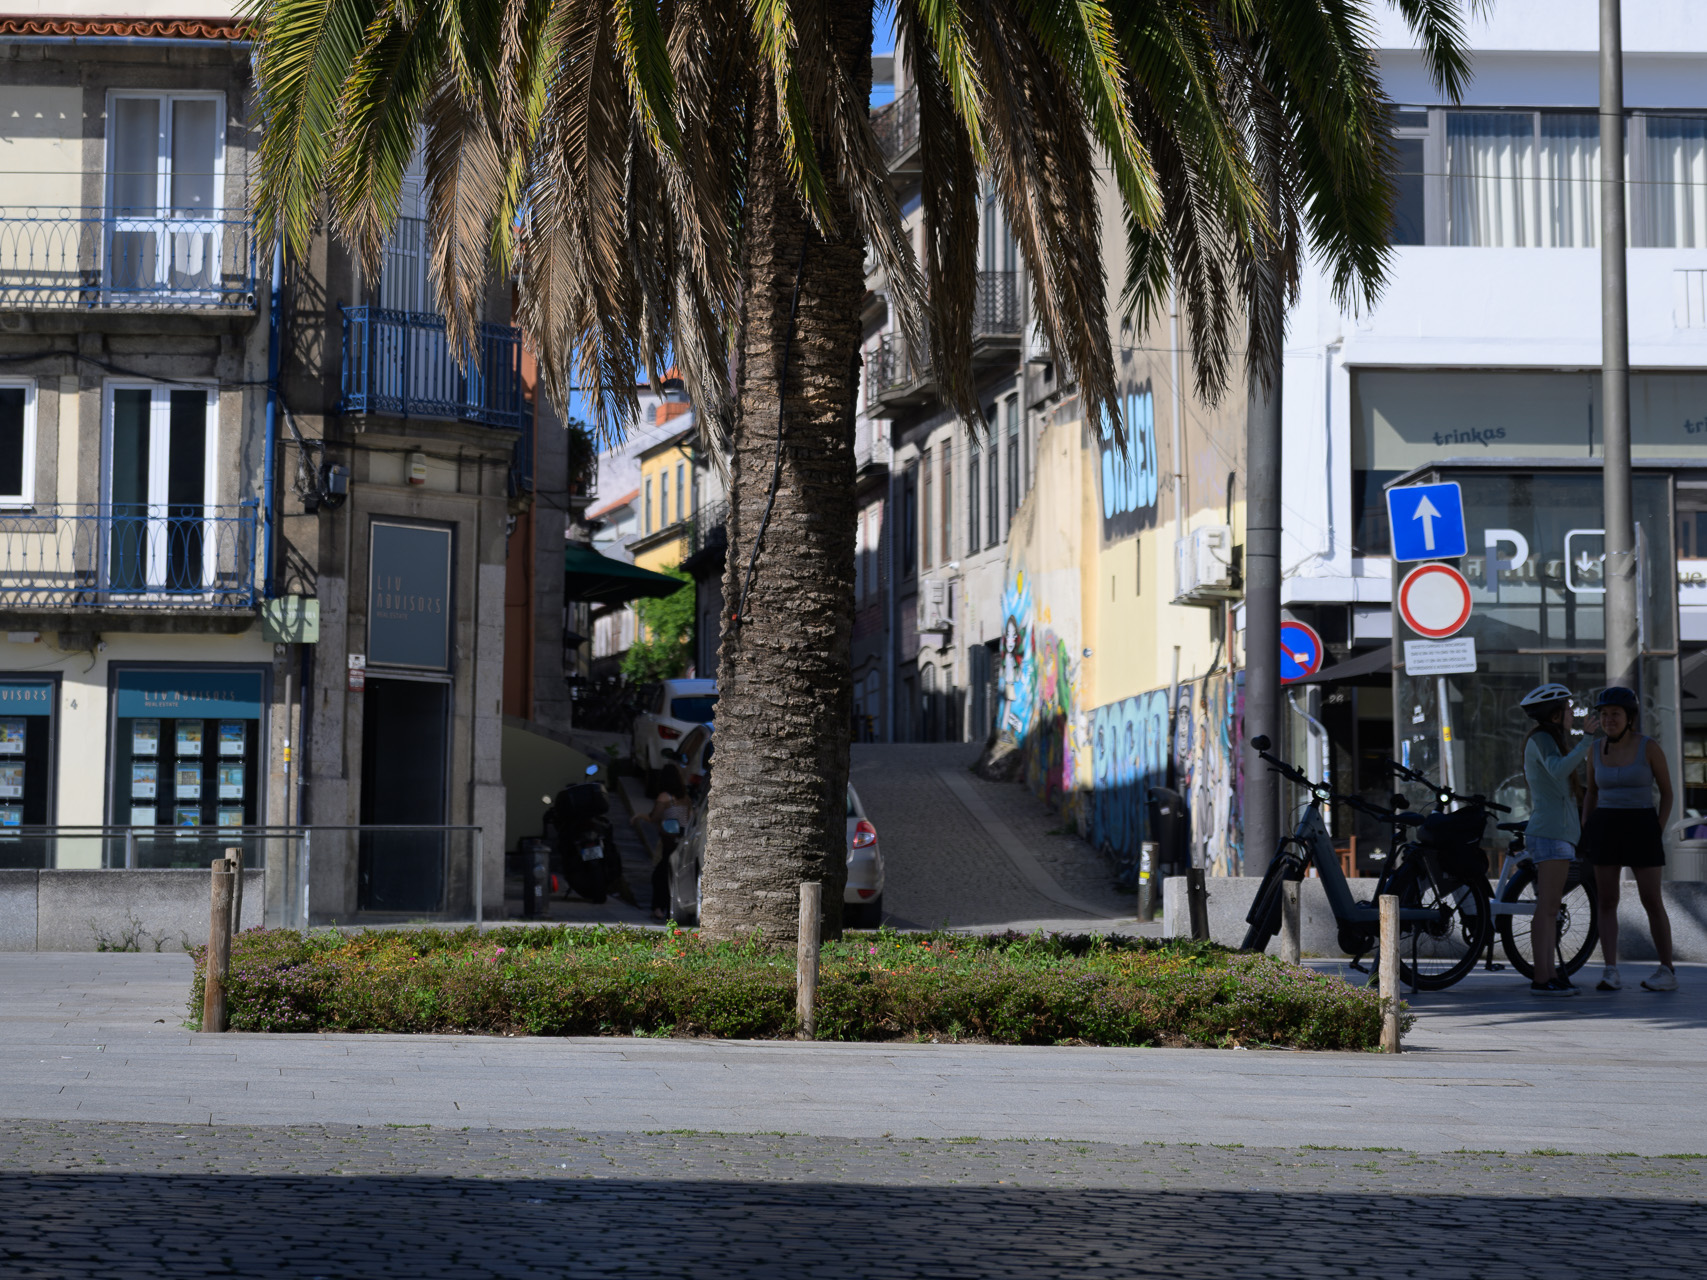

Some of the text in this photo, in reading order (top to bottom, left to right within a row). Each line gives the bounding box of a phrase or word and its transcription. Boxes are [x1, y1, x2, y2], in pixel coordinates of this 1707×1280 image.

[1683, 417, 1707, 434] tri
[1432, 426, 1507, 449] trinkas
[376, 575, 402, 592] LIV
[376, 592, 441, 614] ADVISORS
[1, 689, 48, 701] VISORS
[144, 690, 236, 702] LIV ADVISORS
[70, 698, 79, 711] 4
